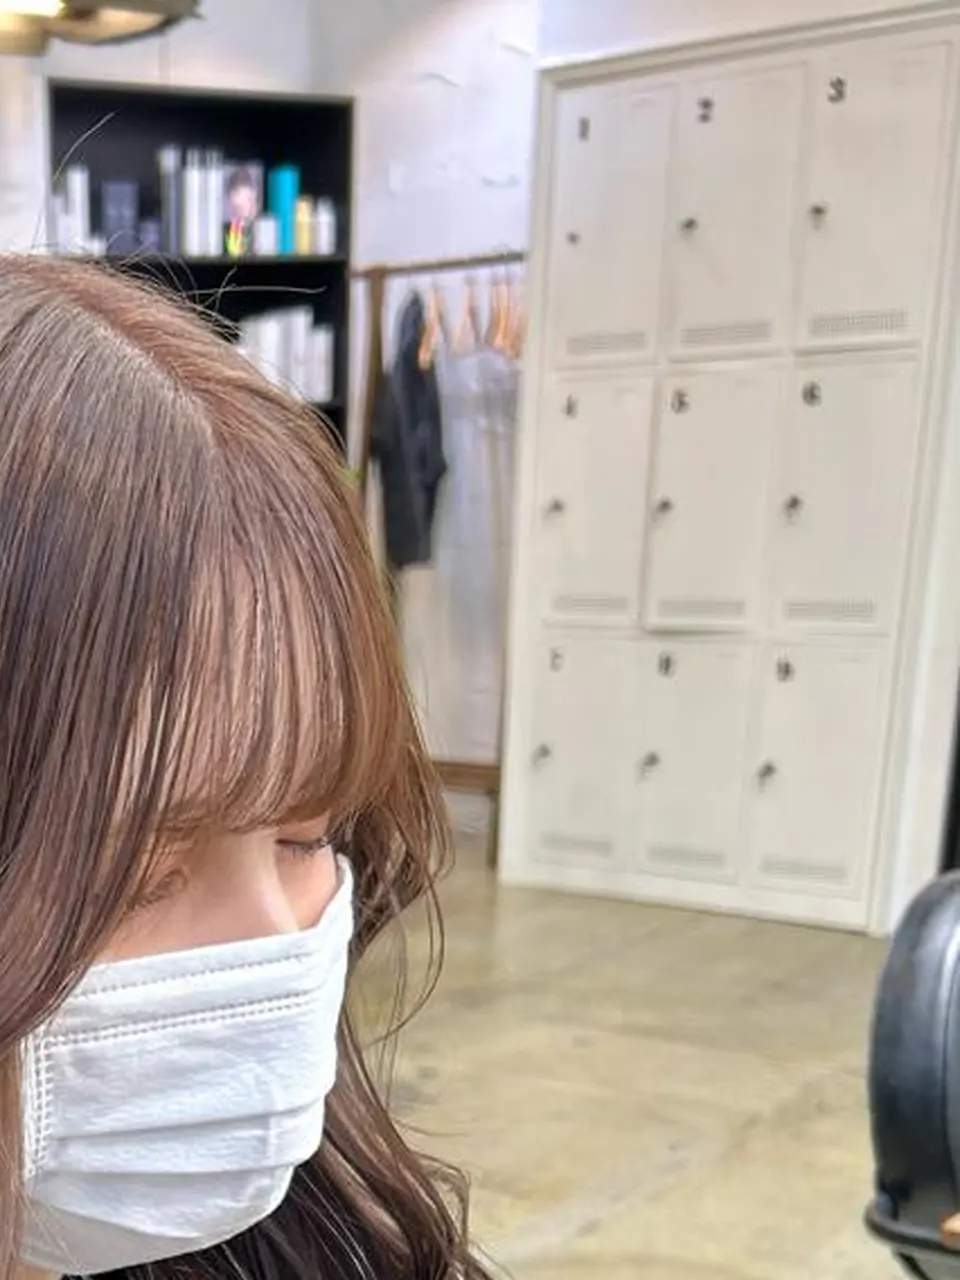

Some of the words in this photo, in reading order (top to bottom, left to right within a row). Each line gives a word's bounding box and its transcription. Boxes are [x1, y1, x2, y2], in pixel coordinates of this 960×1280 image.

[827, 76, 847, 104] 3
[697, 97, 715, 124] 2
[578, 116, 590, 142] 1
